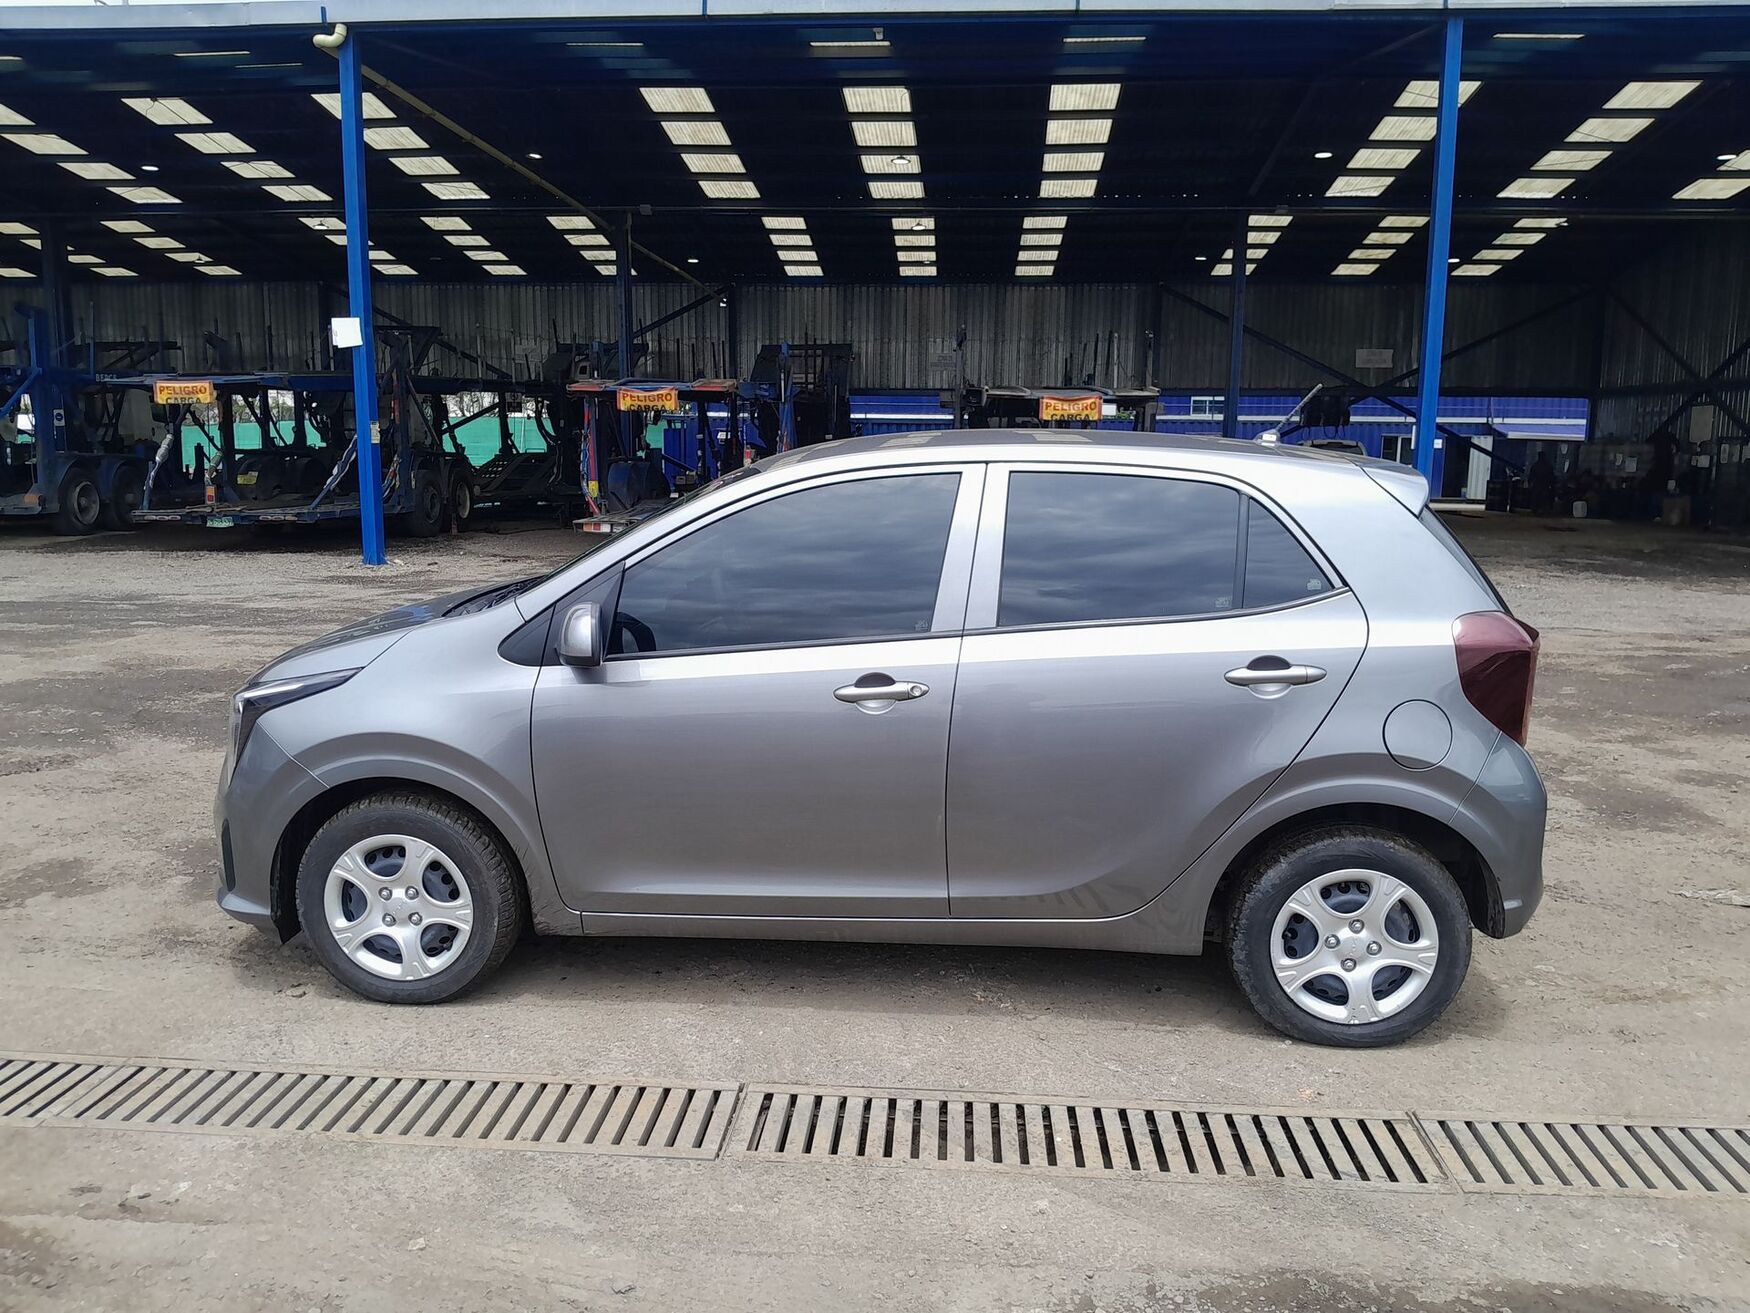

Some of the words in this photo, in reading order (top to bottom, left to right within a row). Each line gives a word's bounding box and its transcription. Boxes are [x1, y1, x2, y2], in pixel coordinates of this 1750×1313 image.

[159, 385, 207, 396] PELIGRO
[622, 392, 673, 403] PELIGRO
[629, 403, 667, 412] CARGA
[1045, 401, 1097, 411] PELIGRO
